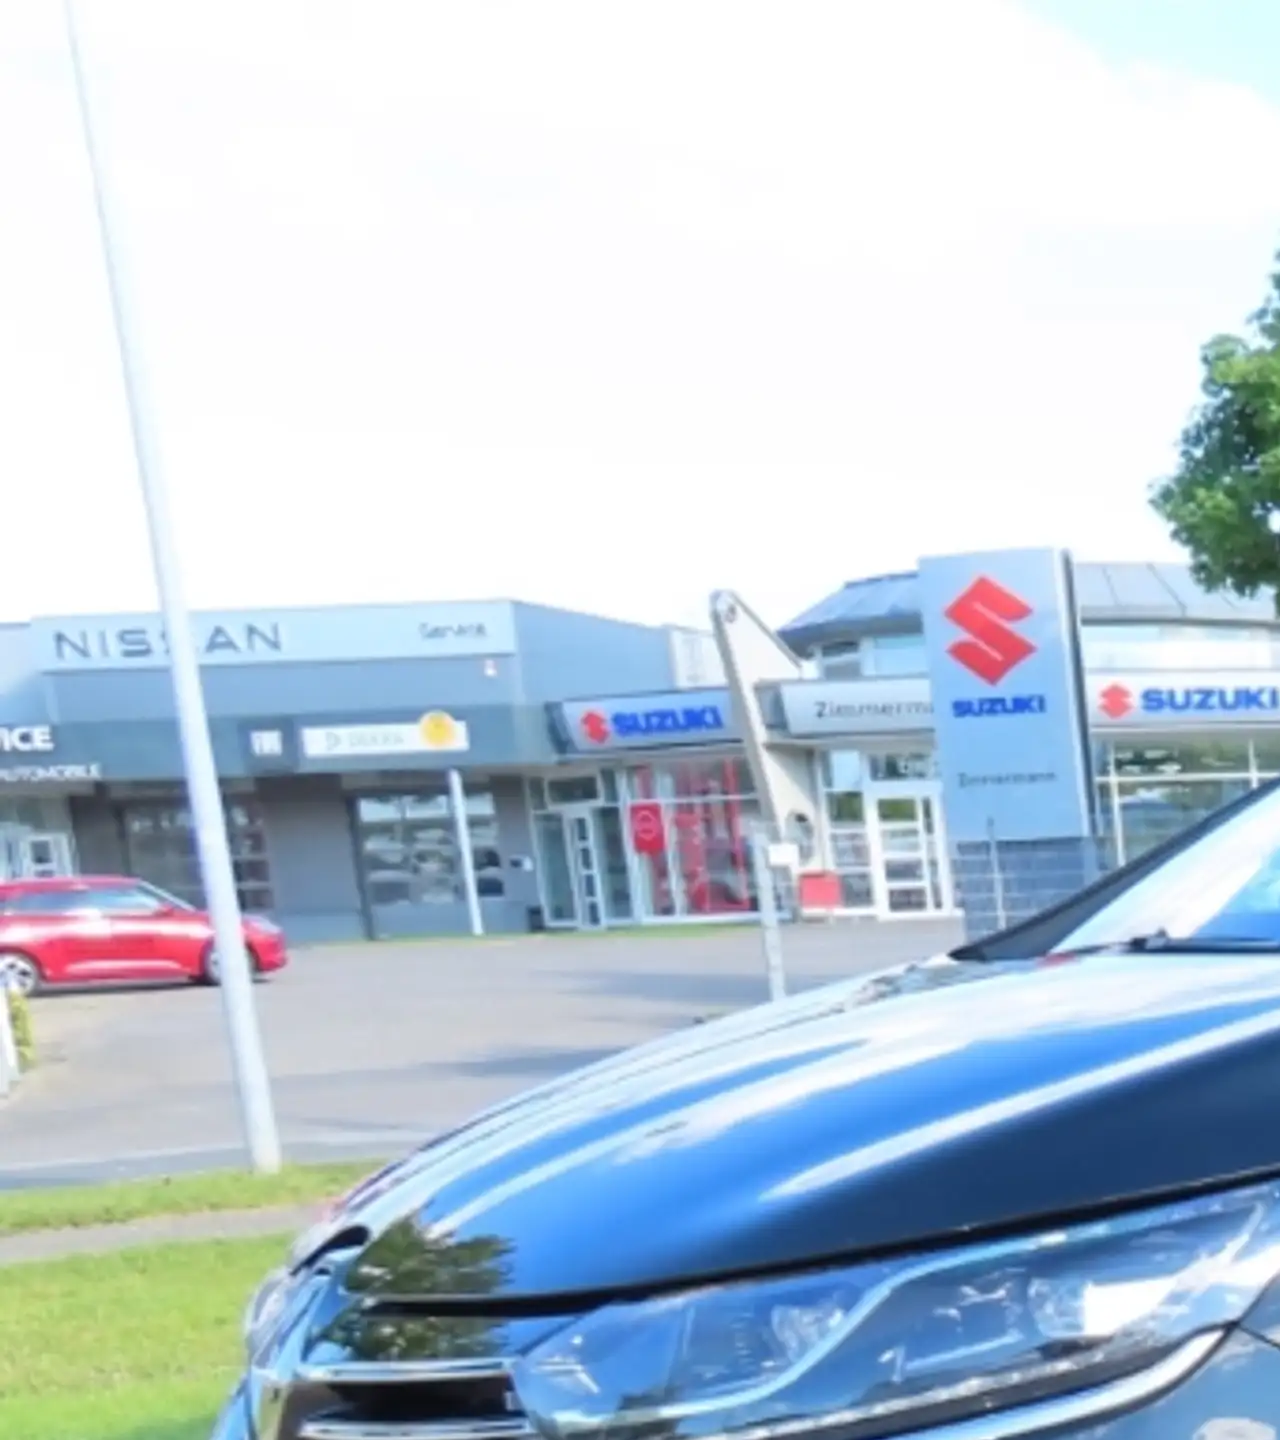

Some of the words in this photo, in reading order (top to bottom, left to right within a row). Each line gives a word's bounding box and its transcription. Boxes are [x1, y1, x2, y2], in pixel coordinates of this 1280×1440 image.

[53, 622, 282, 659] NISAN
[952, 694, 1046, 718] SUZUKI
[1141, 686, 1280, 713] SUZUKI
[612, 705, 724, 737] SUZUKI
